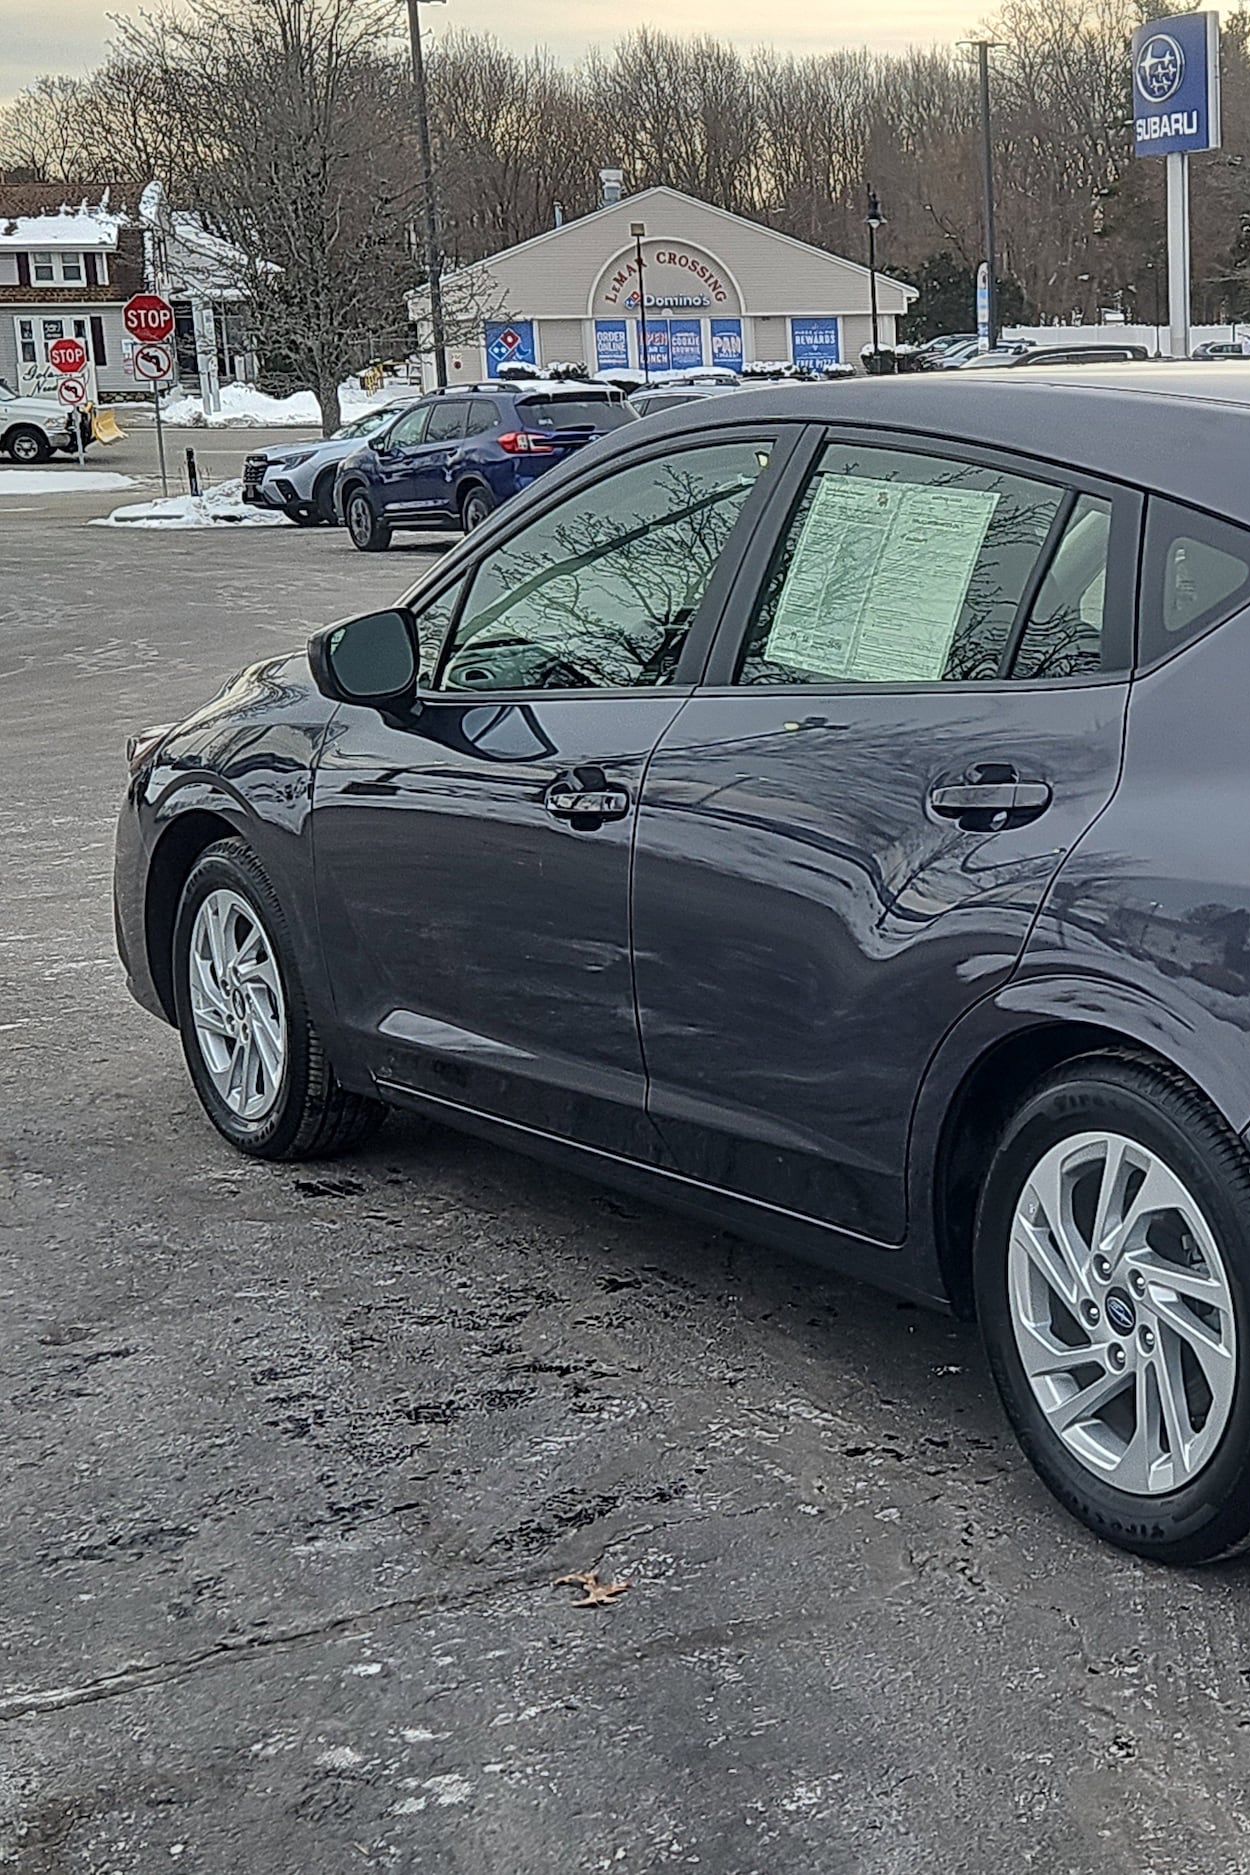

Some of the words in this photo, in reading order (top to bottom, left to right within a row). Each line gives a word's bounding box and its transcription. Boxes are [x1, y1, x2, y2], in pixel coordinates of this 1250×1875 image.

[1136, 110, 1198, 142] SUBARU
[655, 251, 727, 302] CROSSING
[644, 292, 711, 307] Domino's
[127, 309, 171, 328] STOP
[597, 331, 625, 342] ORDER
[712, 336, 741, 354] PAN
[794, 334, 836, 345] REWARDS
[51, 348, 84, 365] STOP
